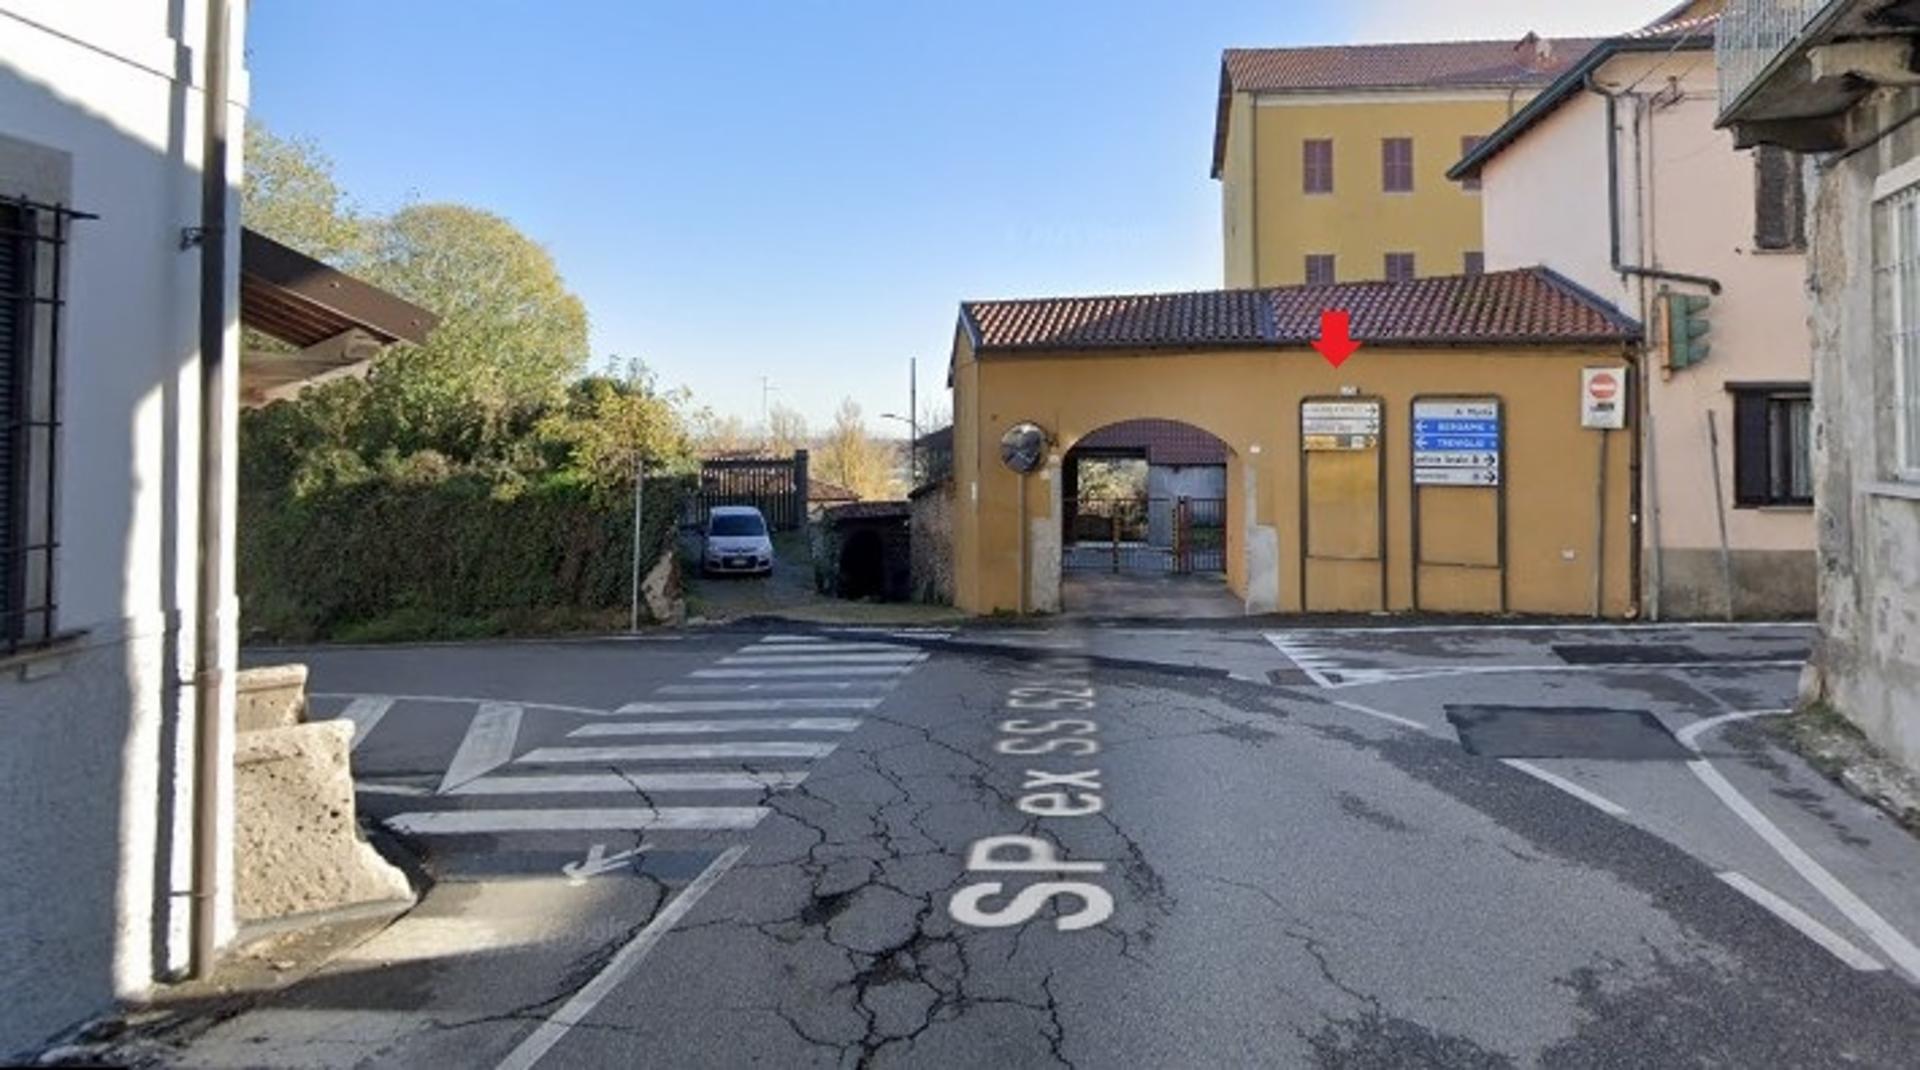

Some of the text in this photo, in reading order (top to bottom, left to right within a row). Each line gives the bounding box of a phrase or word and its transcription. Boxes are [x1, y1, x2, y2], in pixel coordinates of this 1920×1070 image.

[996, 718, 1101, 756] SS
[1017, 768, 1103, 816] ex
[948, 833, 1114, 931] SP
